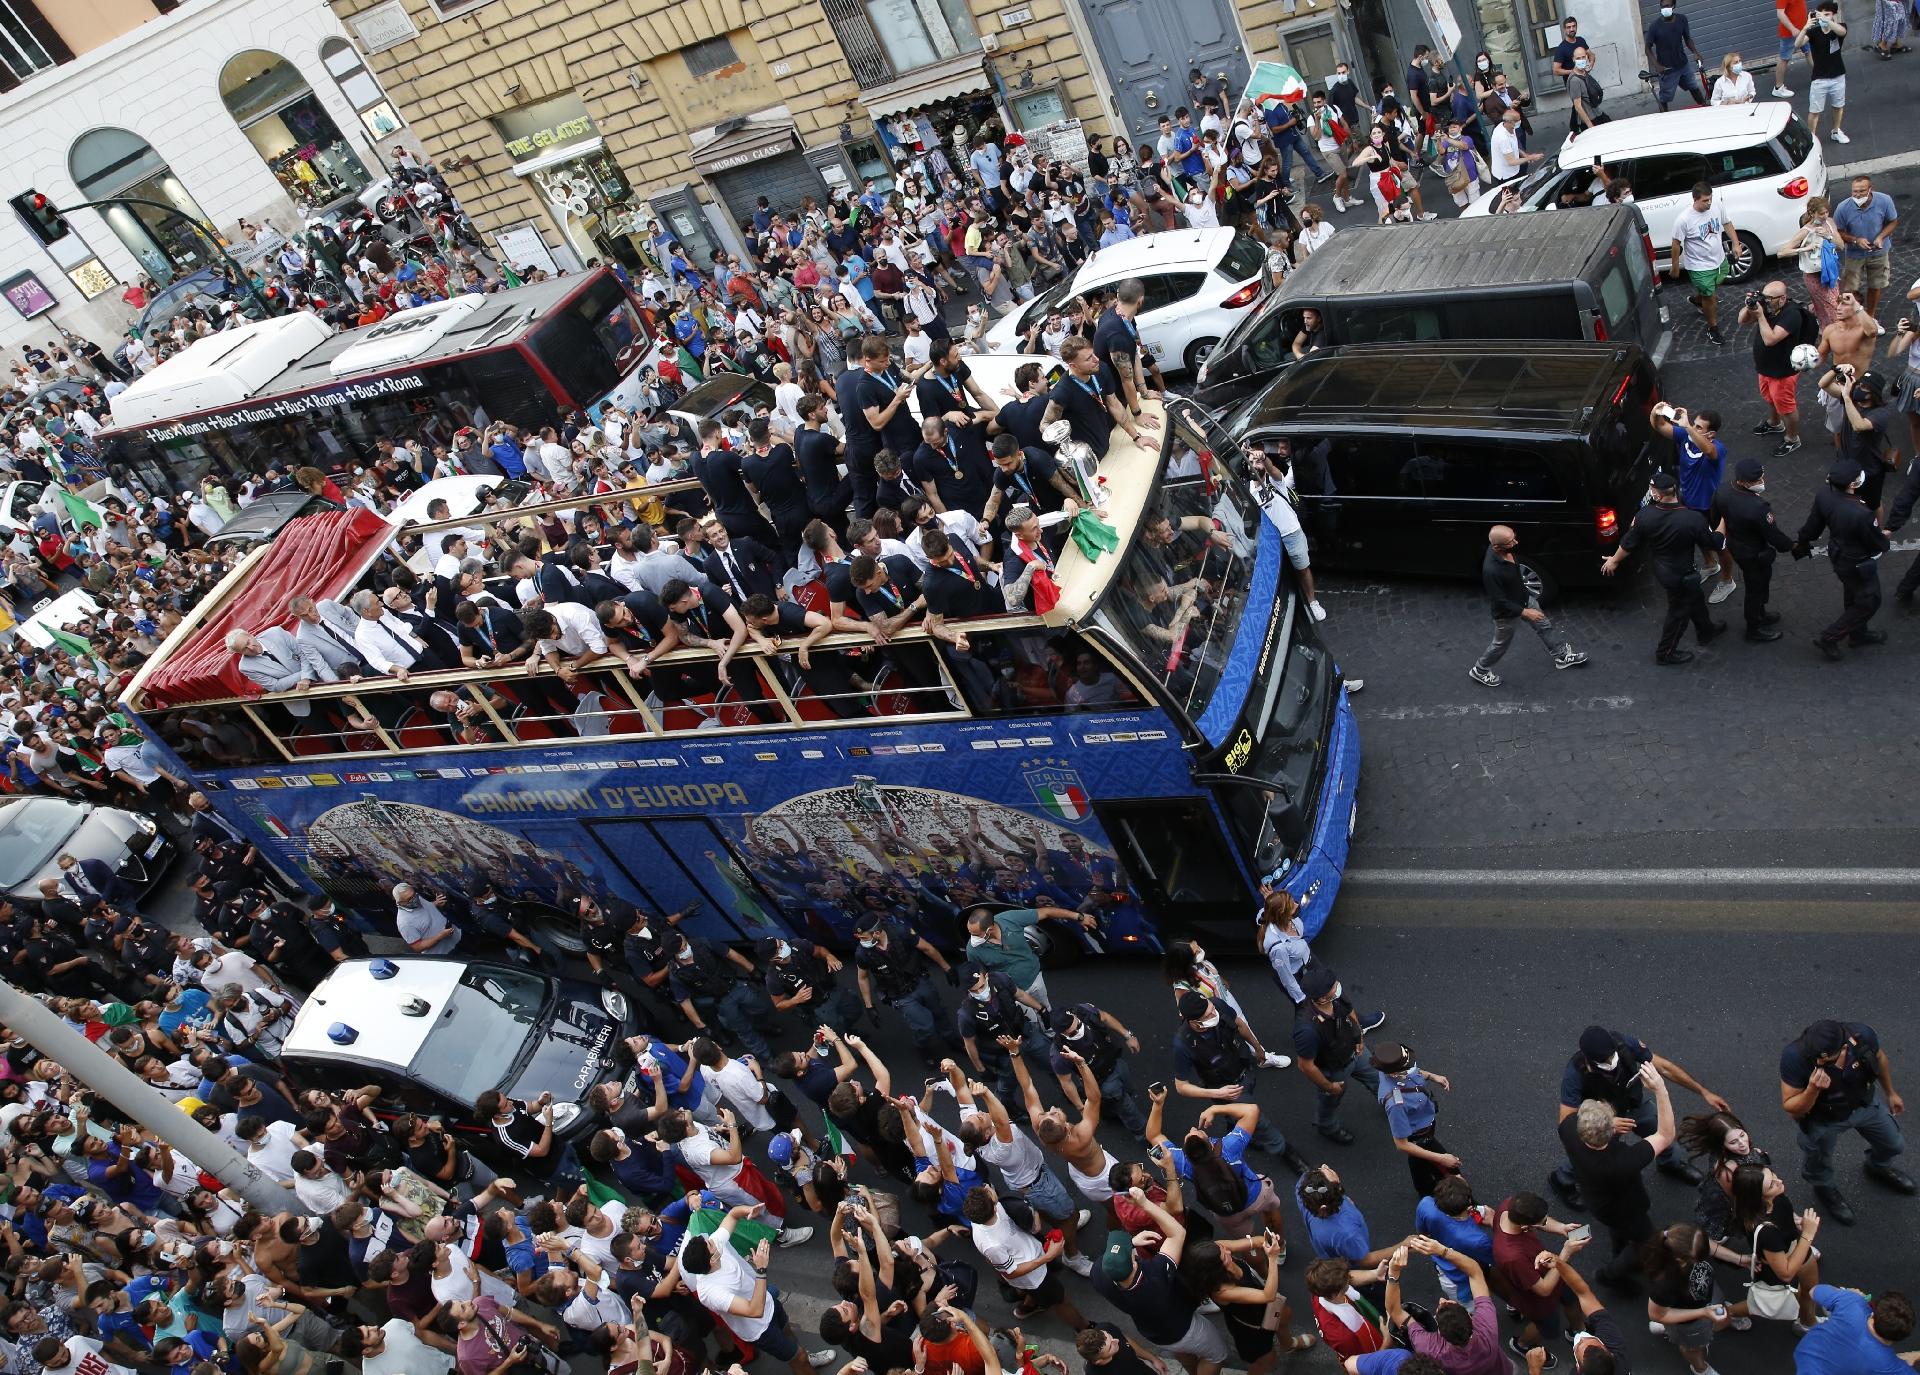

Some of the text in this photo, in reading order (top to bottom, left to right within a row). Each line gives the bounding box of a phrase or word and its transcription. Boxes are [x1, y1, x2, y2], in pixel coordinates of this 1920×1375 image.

[505, 116, 591, 156] THE GELATIST
[711, 144, 781, 171] MURANO GLASS
[1225, 743, 1242, 767] BIG
[1229, 753, 1246, 775] BUS
[1030, 773, 1075, 783] ITALIA
[462, 783, 749, 813] CAMPIONI D'EUROPA
[574, 1024, 613, 1089] CARABINIERI
